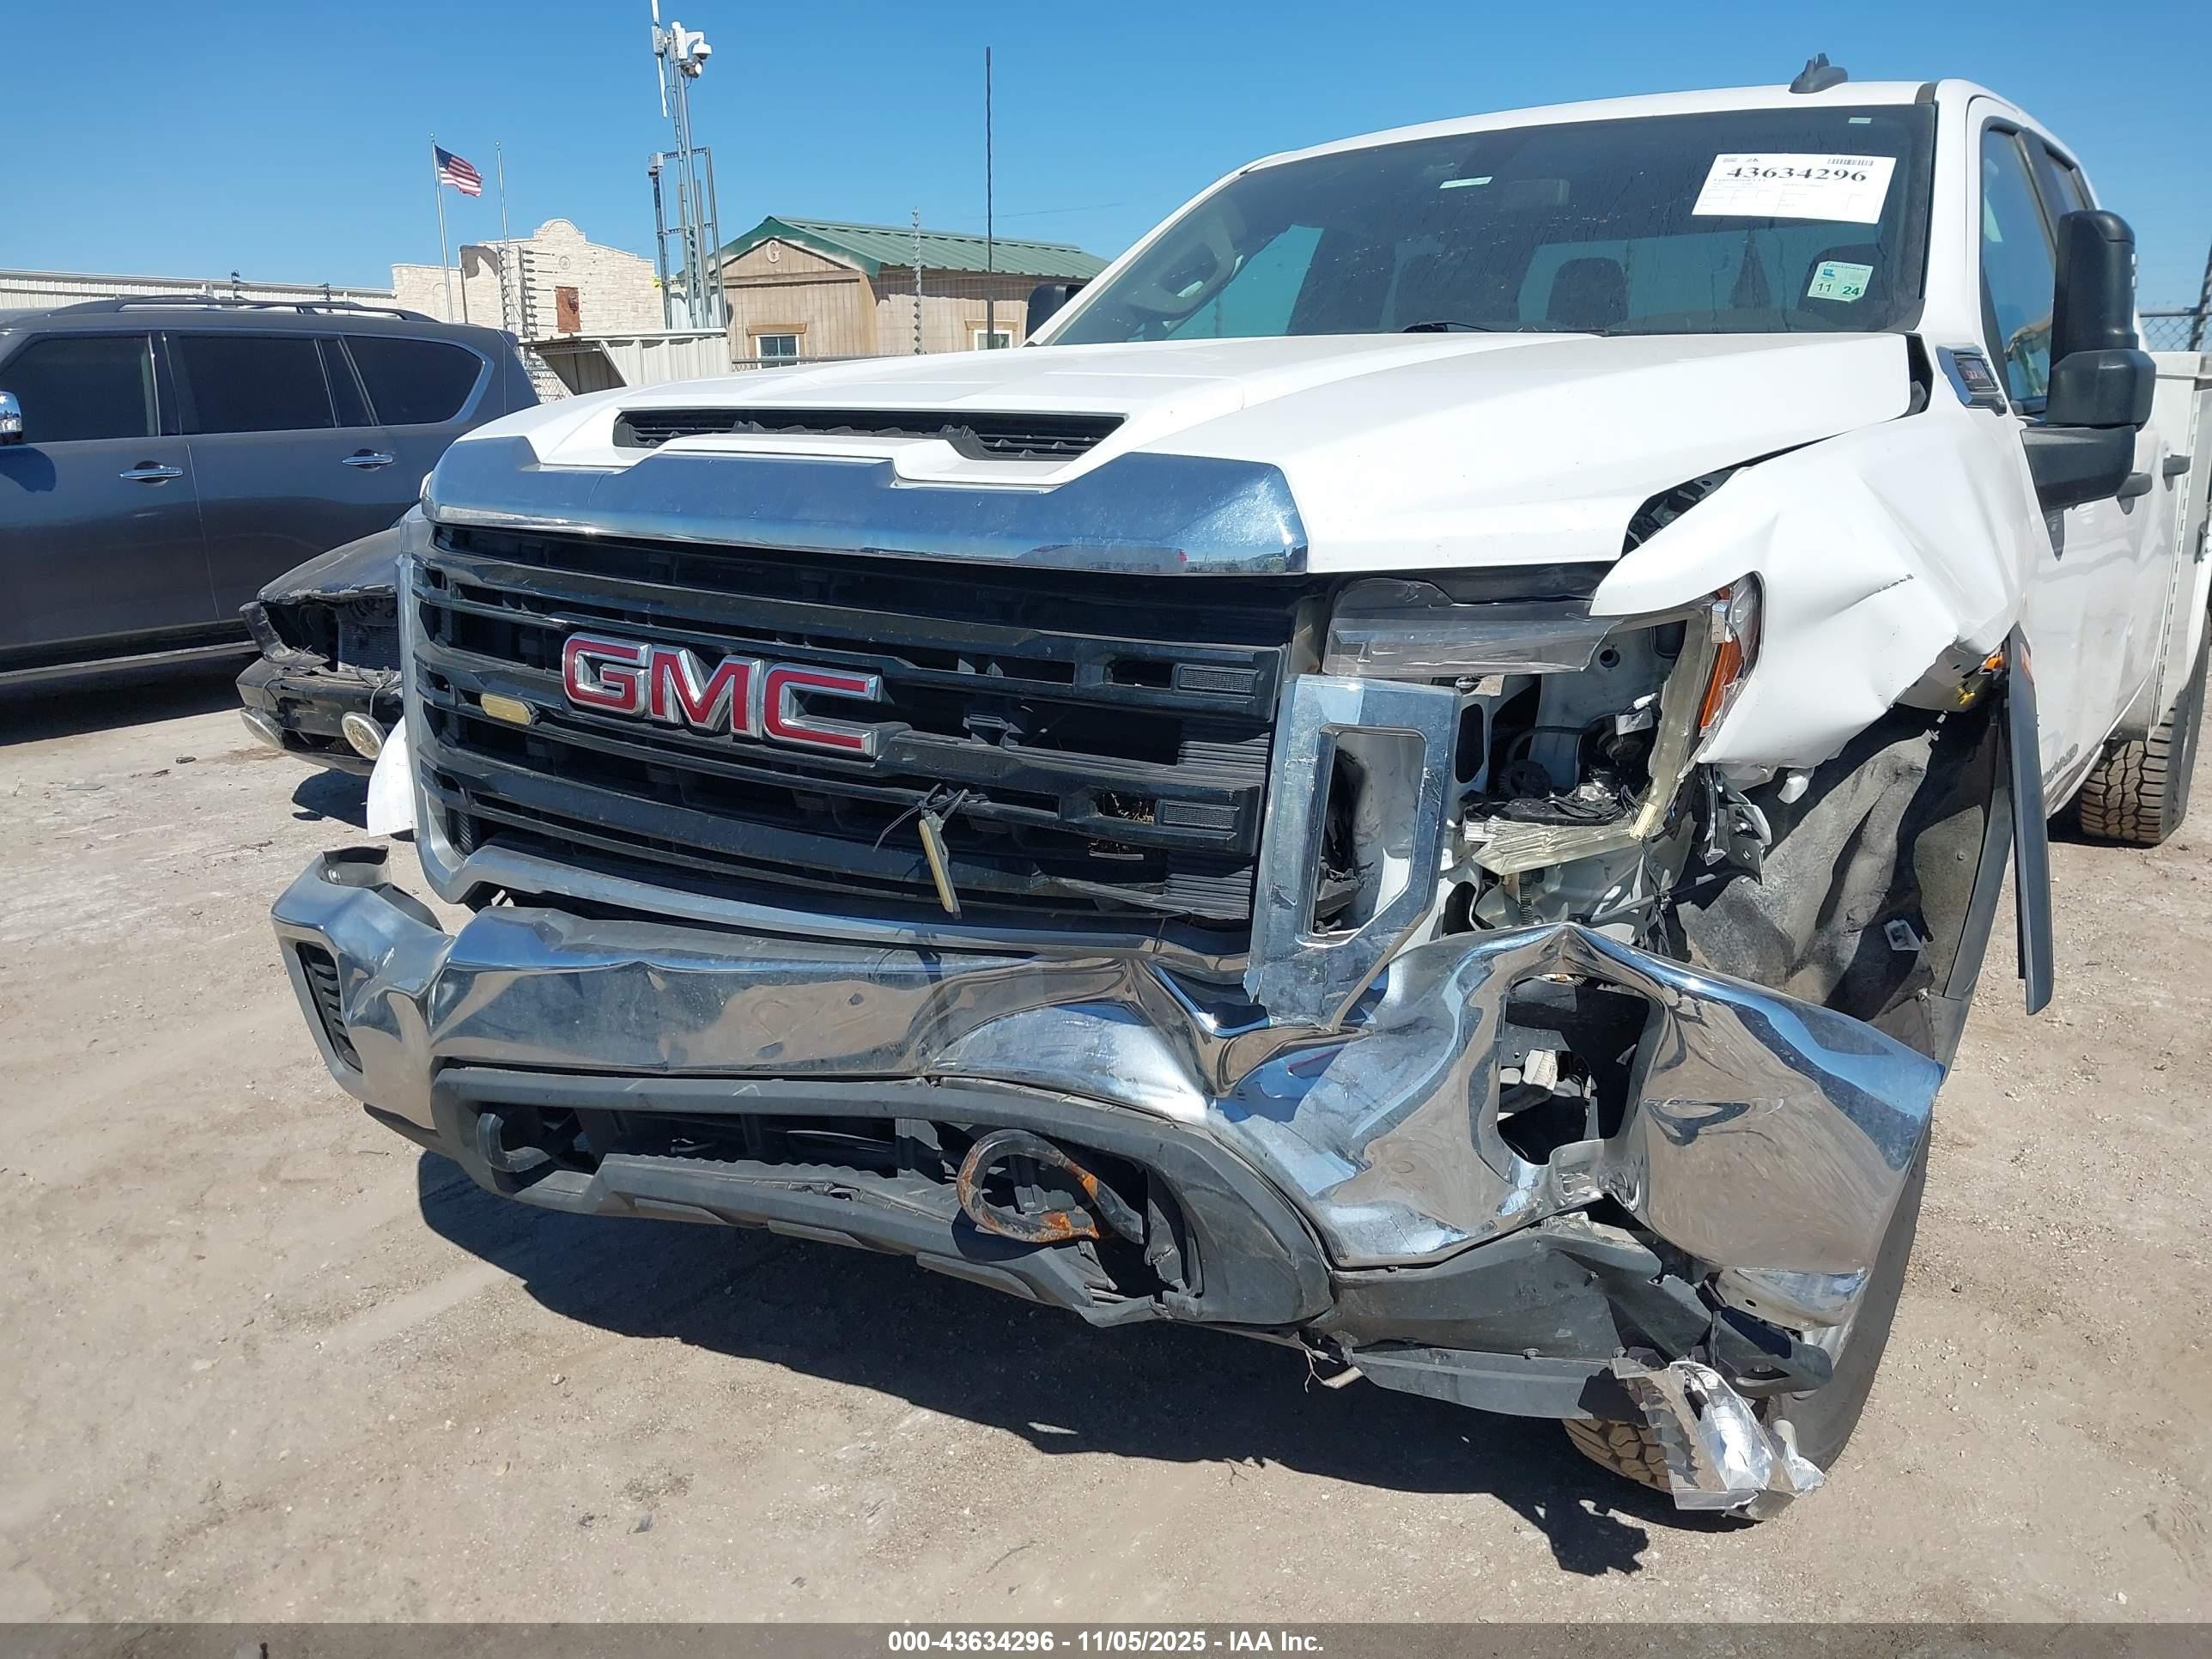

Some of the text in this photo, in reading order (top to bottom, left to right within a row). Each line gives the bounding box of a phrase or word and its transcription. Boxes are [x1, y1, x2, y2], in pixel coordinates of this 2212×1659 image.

[1726, 167, 1868, 182] 43634296
[766, 240, 781, 264] G
[1817, 283, 1860, 296] 11 24
[562, 631, 884, 759] GMC
